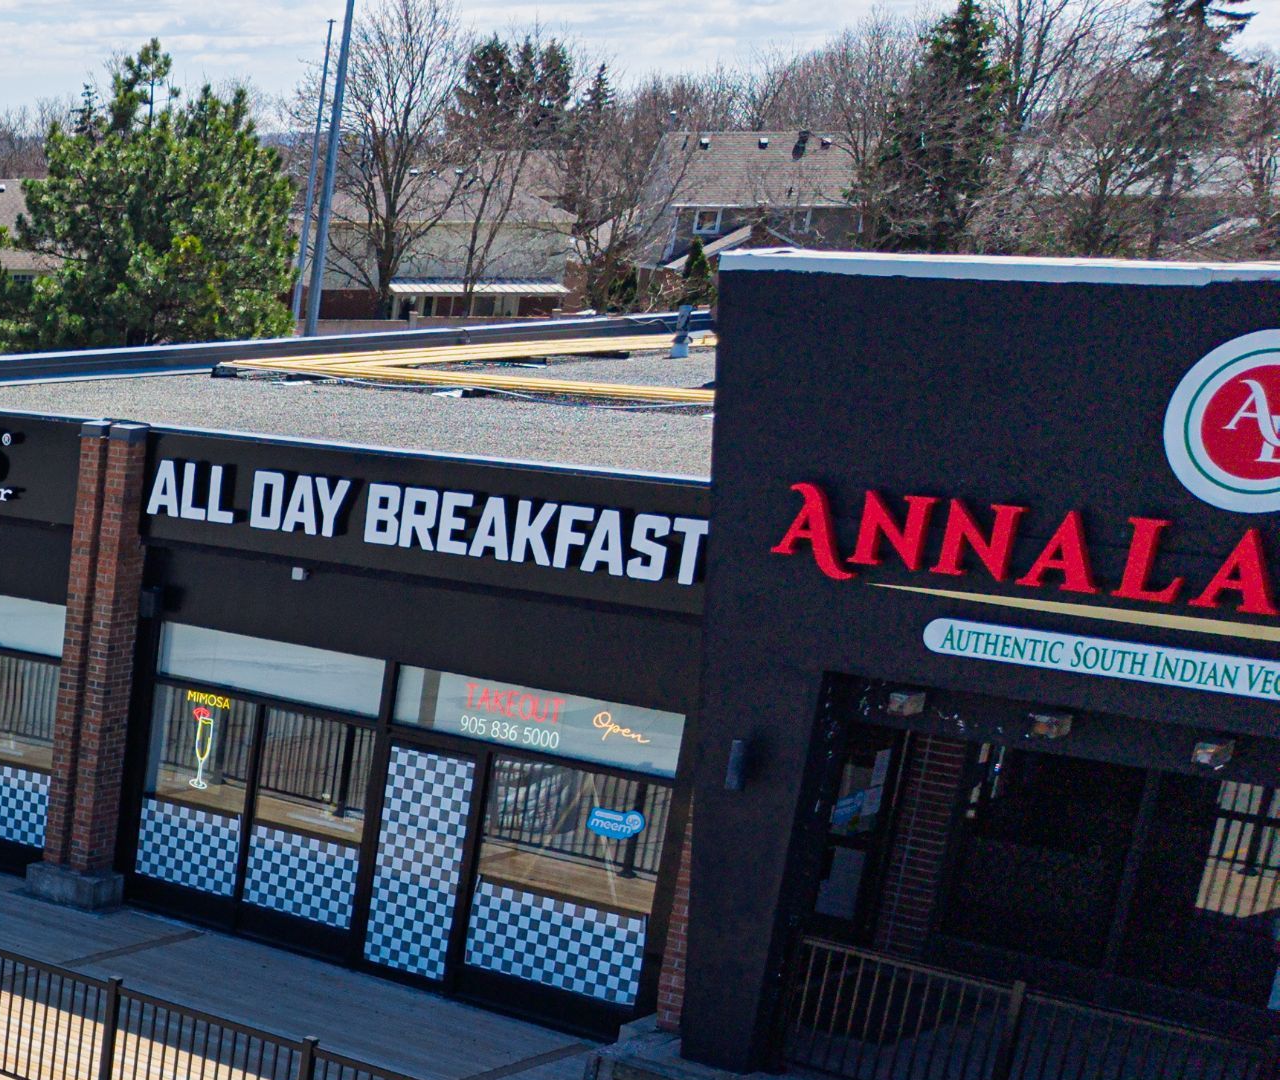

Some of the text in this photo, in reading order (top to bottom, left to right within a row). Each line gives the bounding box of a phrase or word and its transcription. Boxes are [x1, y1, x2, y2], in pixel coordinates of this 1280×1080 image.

[147, 460, 709, 585] ALL DAY BREAKFAST
[940, 624, 1065, 664] AUTHENTIC
[1070, 641, 1150, 677] SOUTH
[1152, 651, 1241, 689] INDIAN
[187, 690, 230, 709] MIMOSA
[465, 682, 566, 724] TAKEOUT
[460, 715, 560, 749] 905 836 5000
[593, 711, 651, 743] Open
[591, 818, 631, 834] meem
